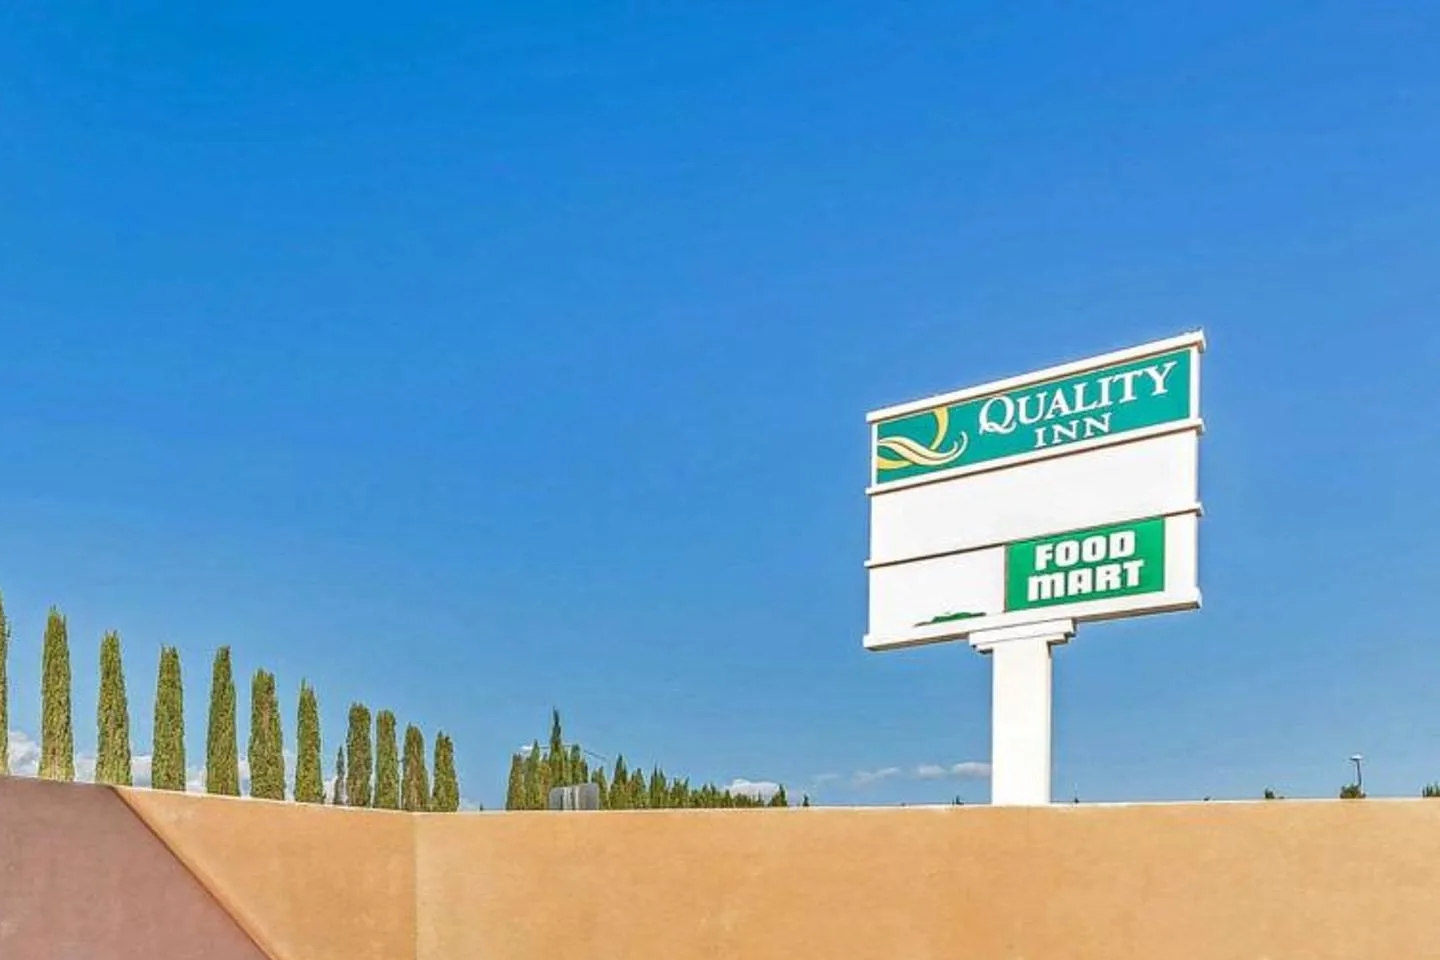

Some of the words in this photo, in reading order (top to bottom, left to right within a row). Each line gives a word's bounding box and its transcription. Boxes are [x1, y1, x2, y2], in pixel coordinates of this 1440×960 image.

[978, 361, 1178, 434] QUALITY
[1034, 412, 1113, 448] INN
[1034, 530, 1136, 571] FOOD
[1026, 560, 1145, 601] MART
